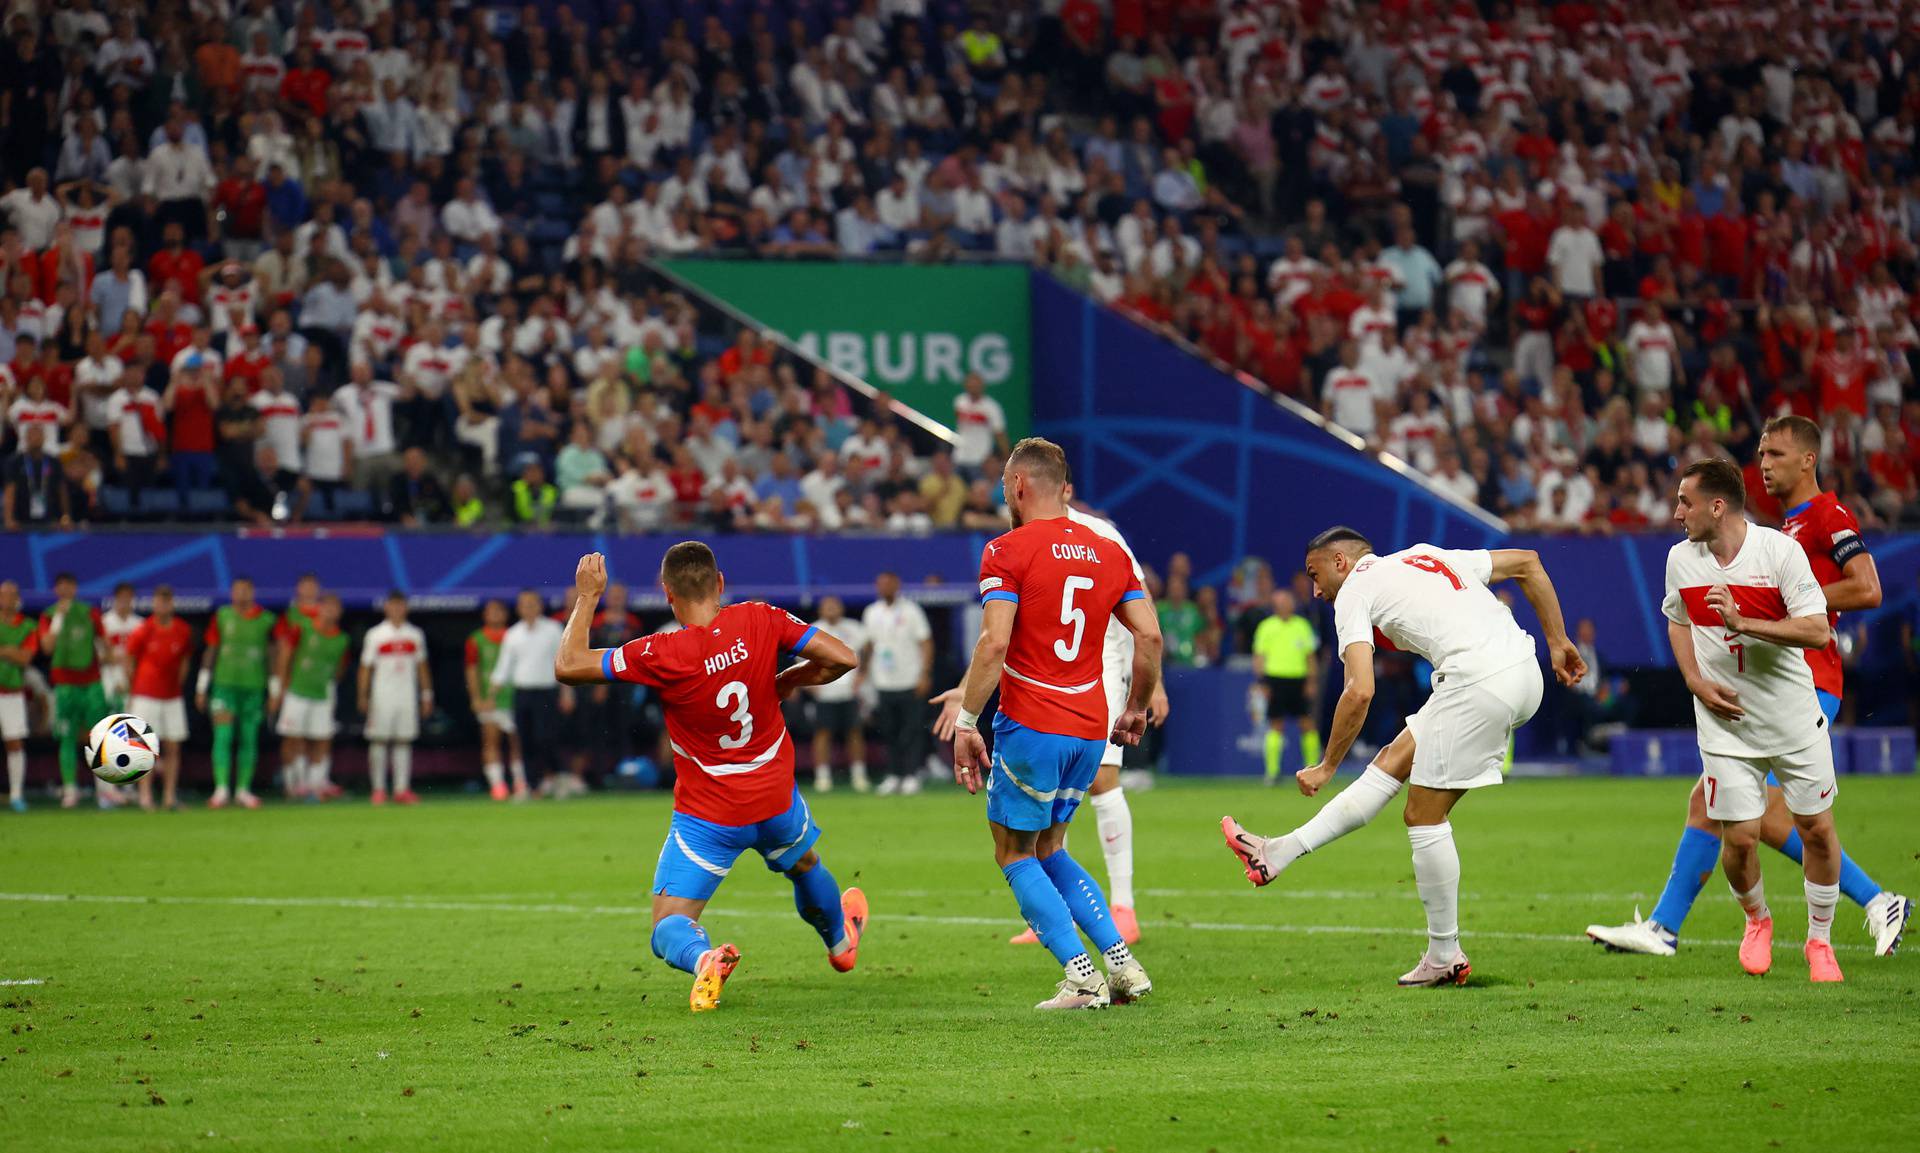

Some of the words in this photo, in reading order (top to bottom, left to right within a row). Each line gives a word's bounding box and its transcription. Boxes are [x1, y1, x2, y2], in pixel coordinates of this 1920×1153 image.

[1052, 543, 1101, 564] COUFAL
[1402, 554, 1467, 591] 9
[1053, 575, 1094, 662] 5
[704, 637, 749, 675] HOLEŠ
[1729, 643, 1745, 673] 7
[716, 681, 753, 749] 3
[1707, 776, 1718, 809] 7
